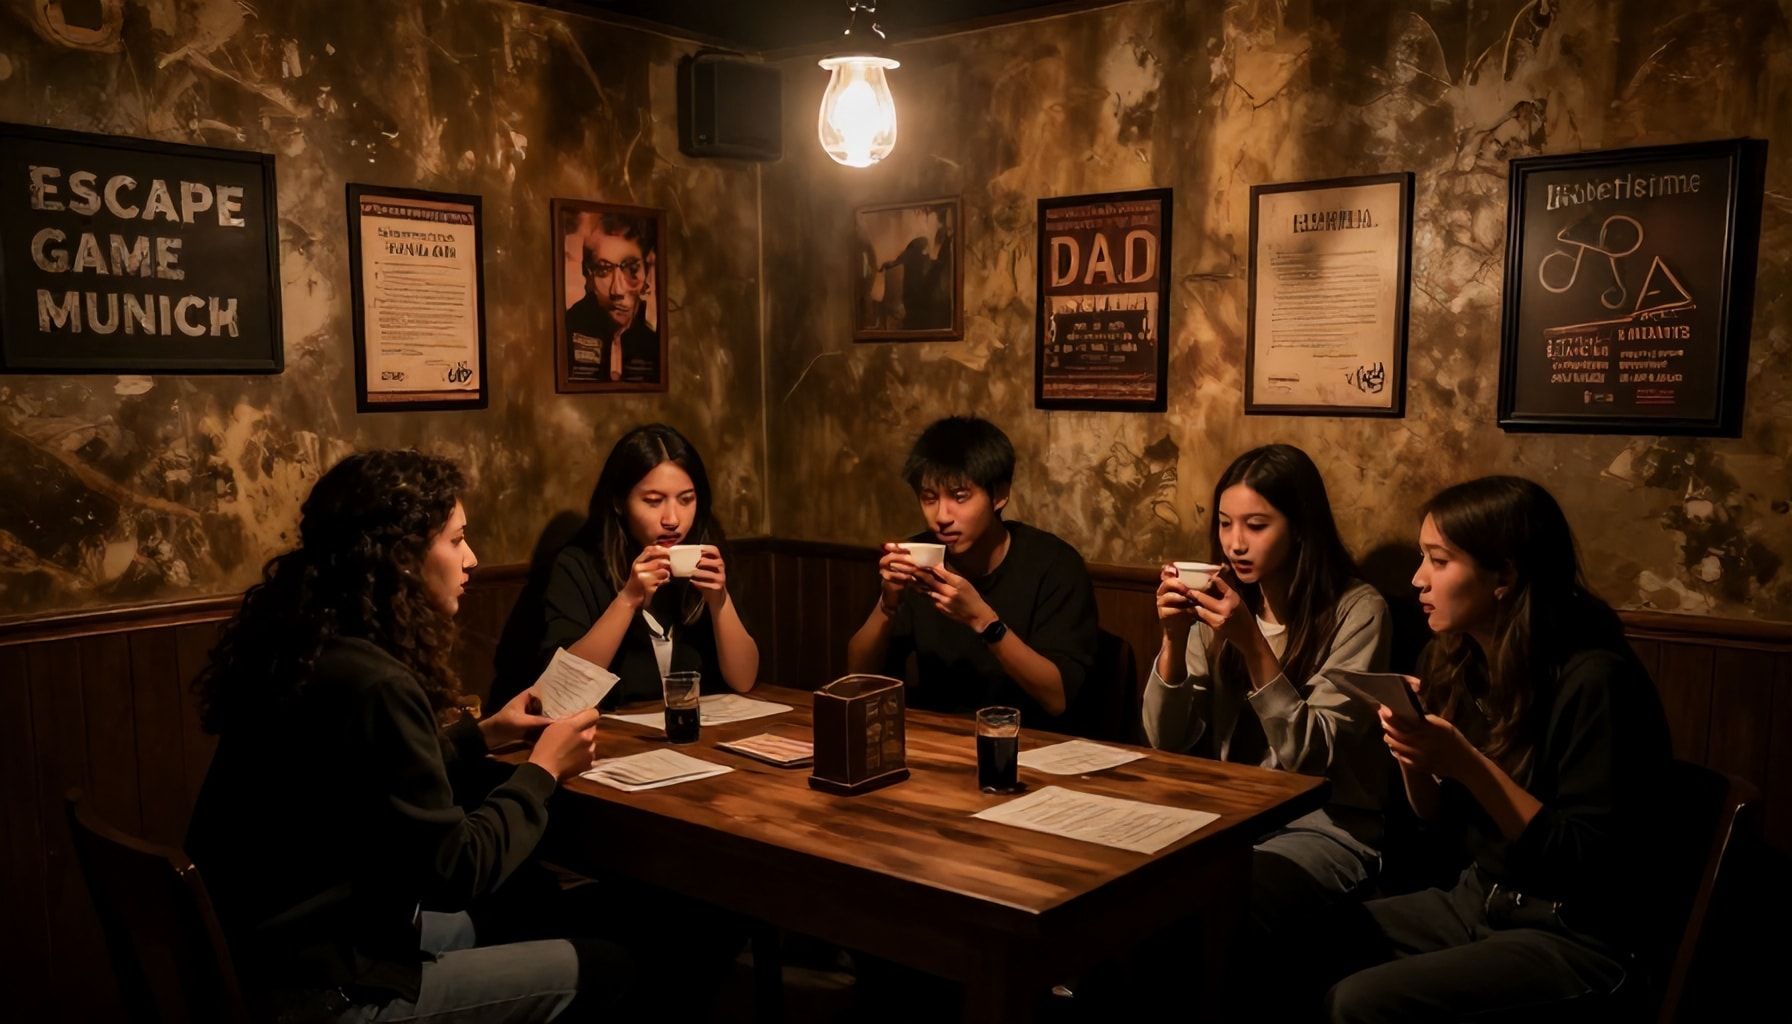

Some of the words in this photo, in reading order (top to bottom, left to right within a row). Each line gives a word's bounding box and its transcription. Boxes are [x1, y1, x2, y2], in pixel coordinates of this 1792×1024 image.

[29, 165, 245, 227] ESCAPE
[31, 228, 185, 280] GAME
[1051, 229, 1156, 287] DAD
[37, 289, 239, 338] MUNICH
